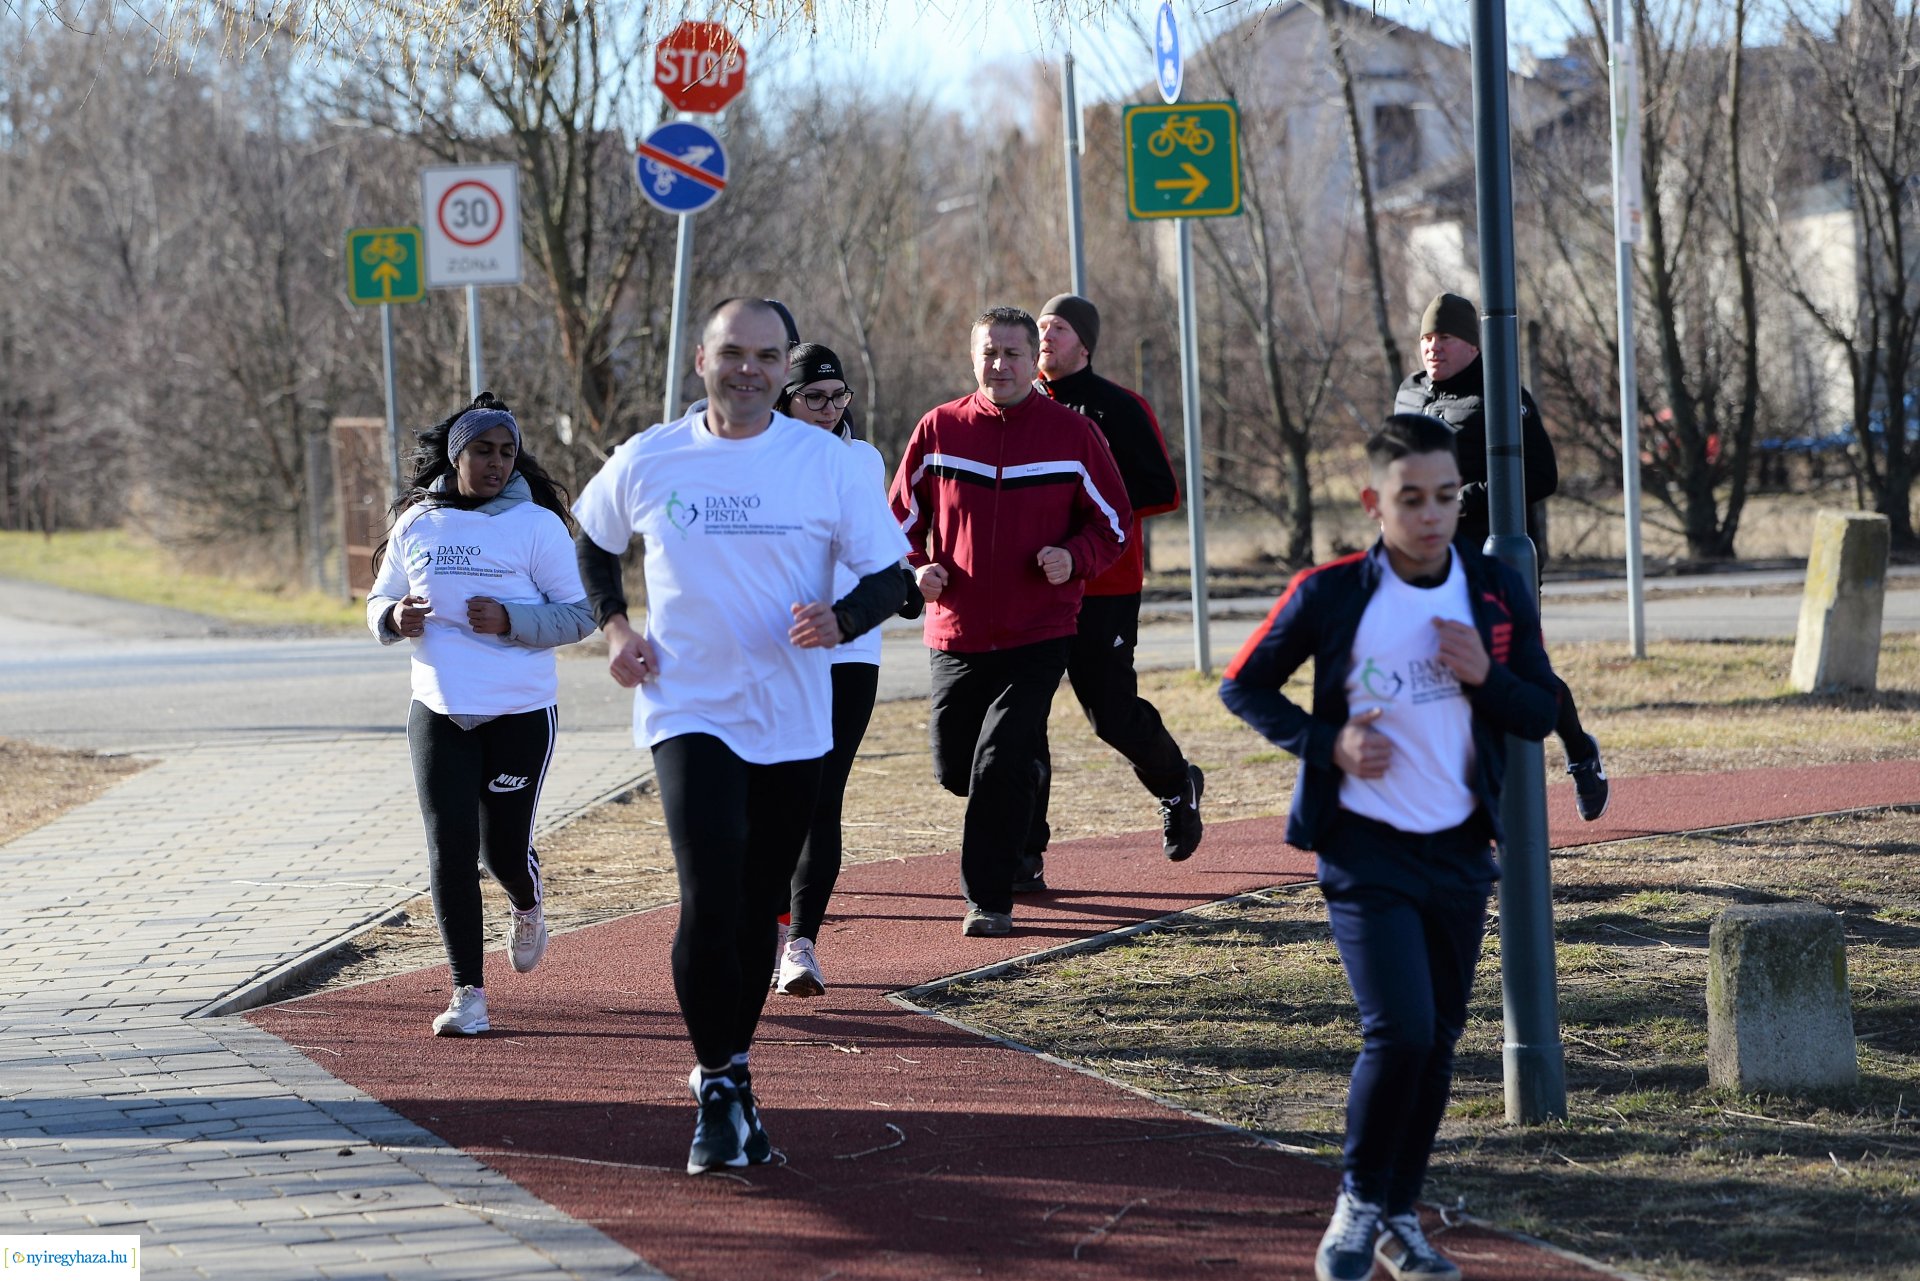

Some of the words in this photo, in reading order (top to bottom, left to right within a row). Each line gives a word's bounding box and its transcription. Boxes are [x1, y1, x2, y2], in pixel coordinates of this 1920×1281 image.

[657, 47, 743, 88] STOP
[452, 197, 489, 229] 30
[704, 509, 749, 522] PISTA
[435, 555, 471, 566] PISTA
[495, 773, 529, 787] NIKE
